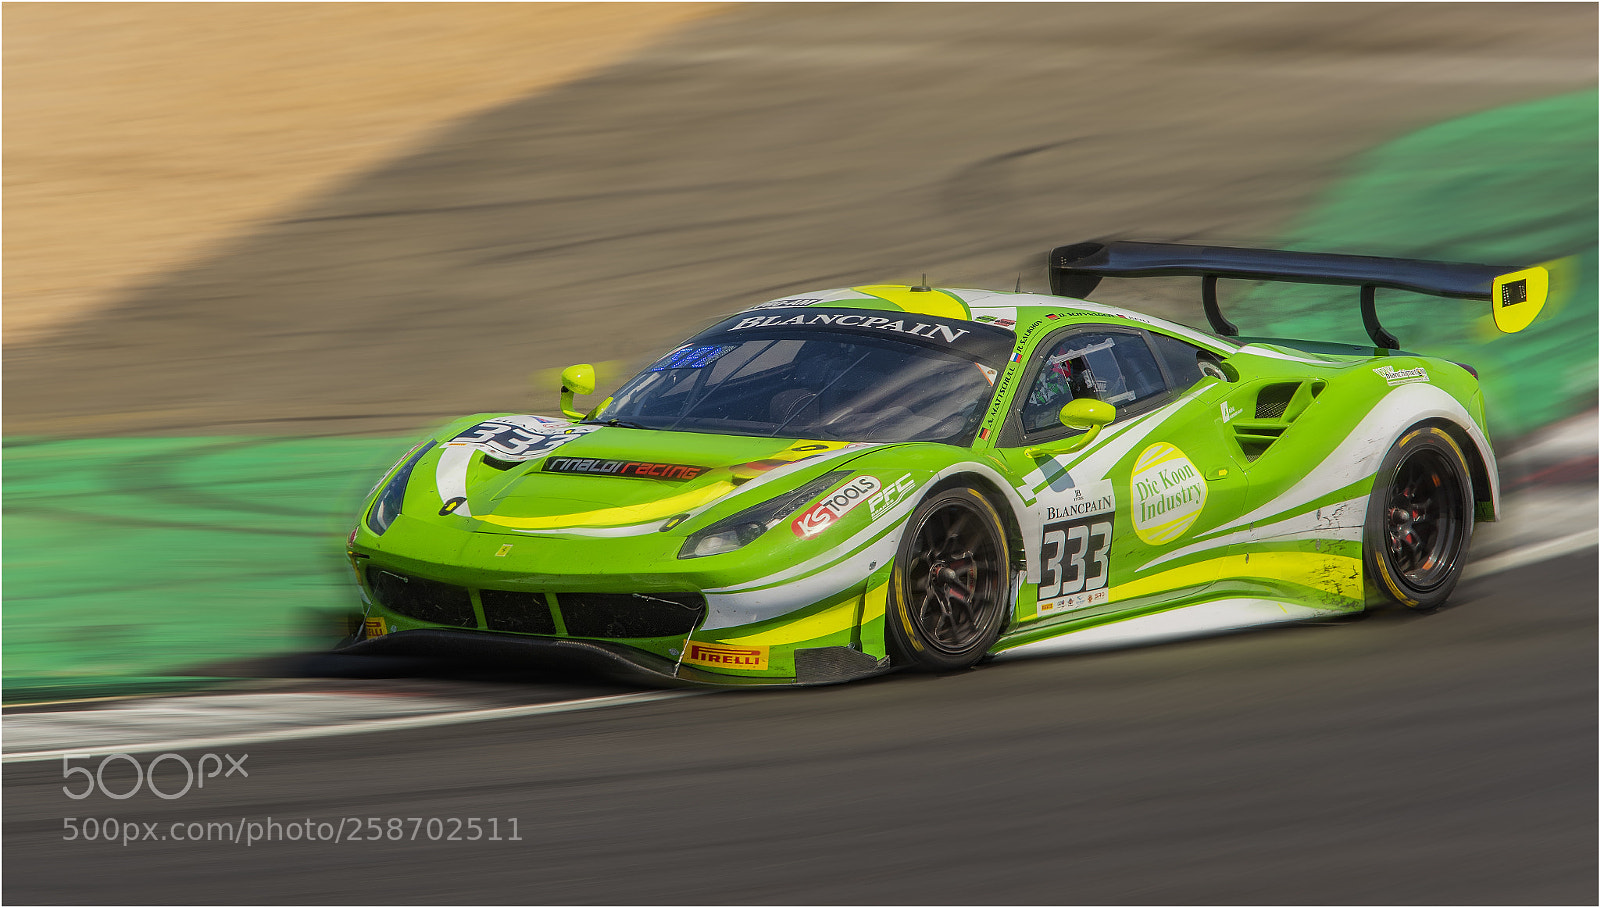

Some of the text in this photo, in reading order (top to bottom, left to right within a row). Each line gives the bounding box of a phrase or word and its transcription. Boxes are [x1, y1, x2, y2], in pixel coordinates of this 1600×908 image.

[730, 314, 970, 343] BLANCPAIN
[867, 471, 914, 514] PFC
[1135, 464, 1195, 502] Dic Koon
[1140, 482, 1202, 523] Industry
[797, 478, 875, 537] KS TOOLS
[1047, 495, 1112, 520] BLANCPAIN
[1038, 521, 1113, 600] 333
[690, 645, 760, 665] PIRELLI
